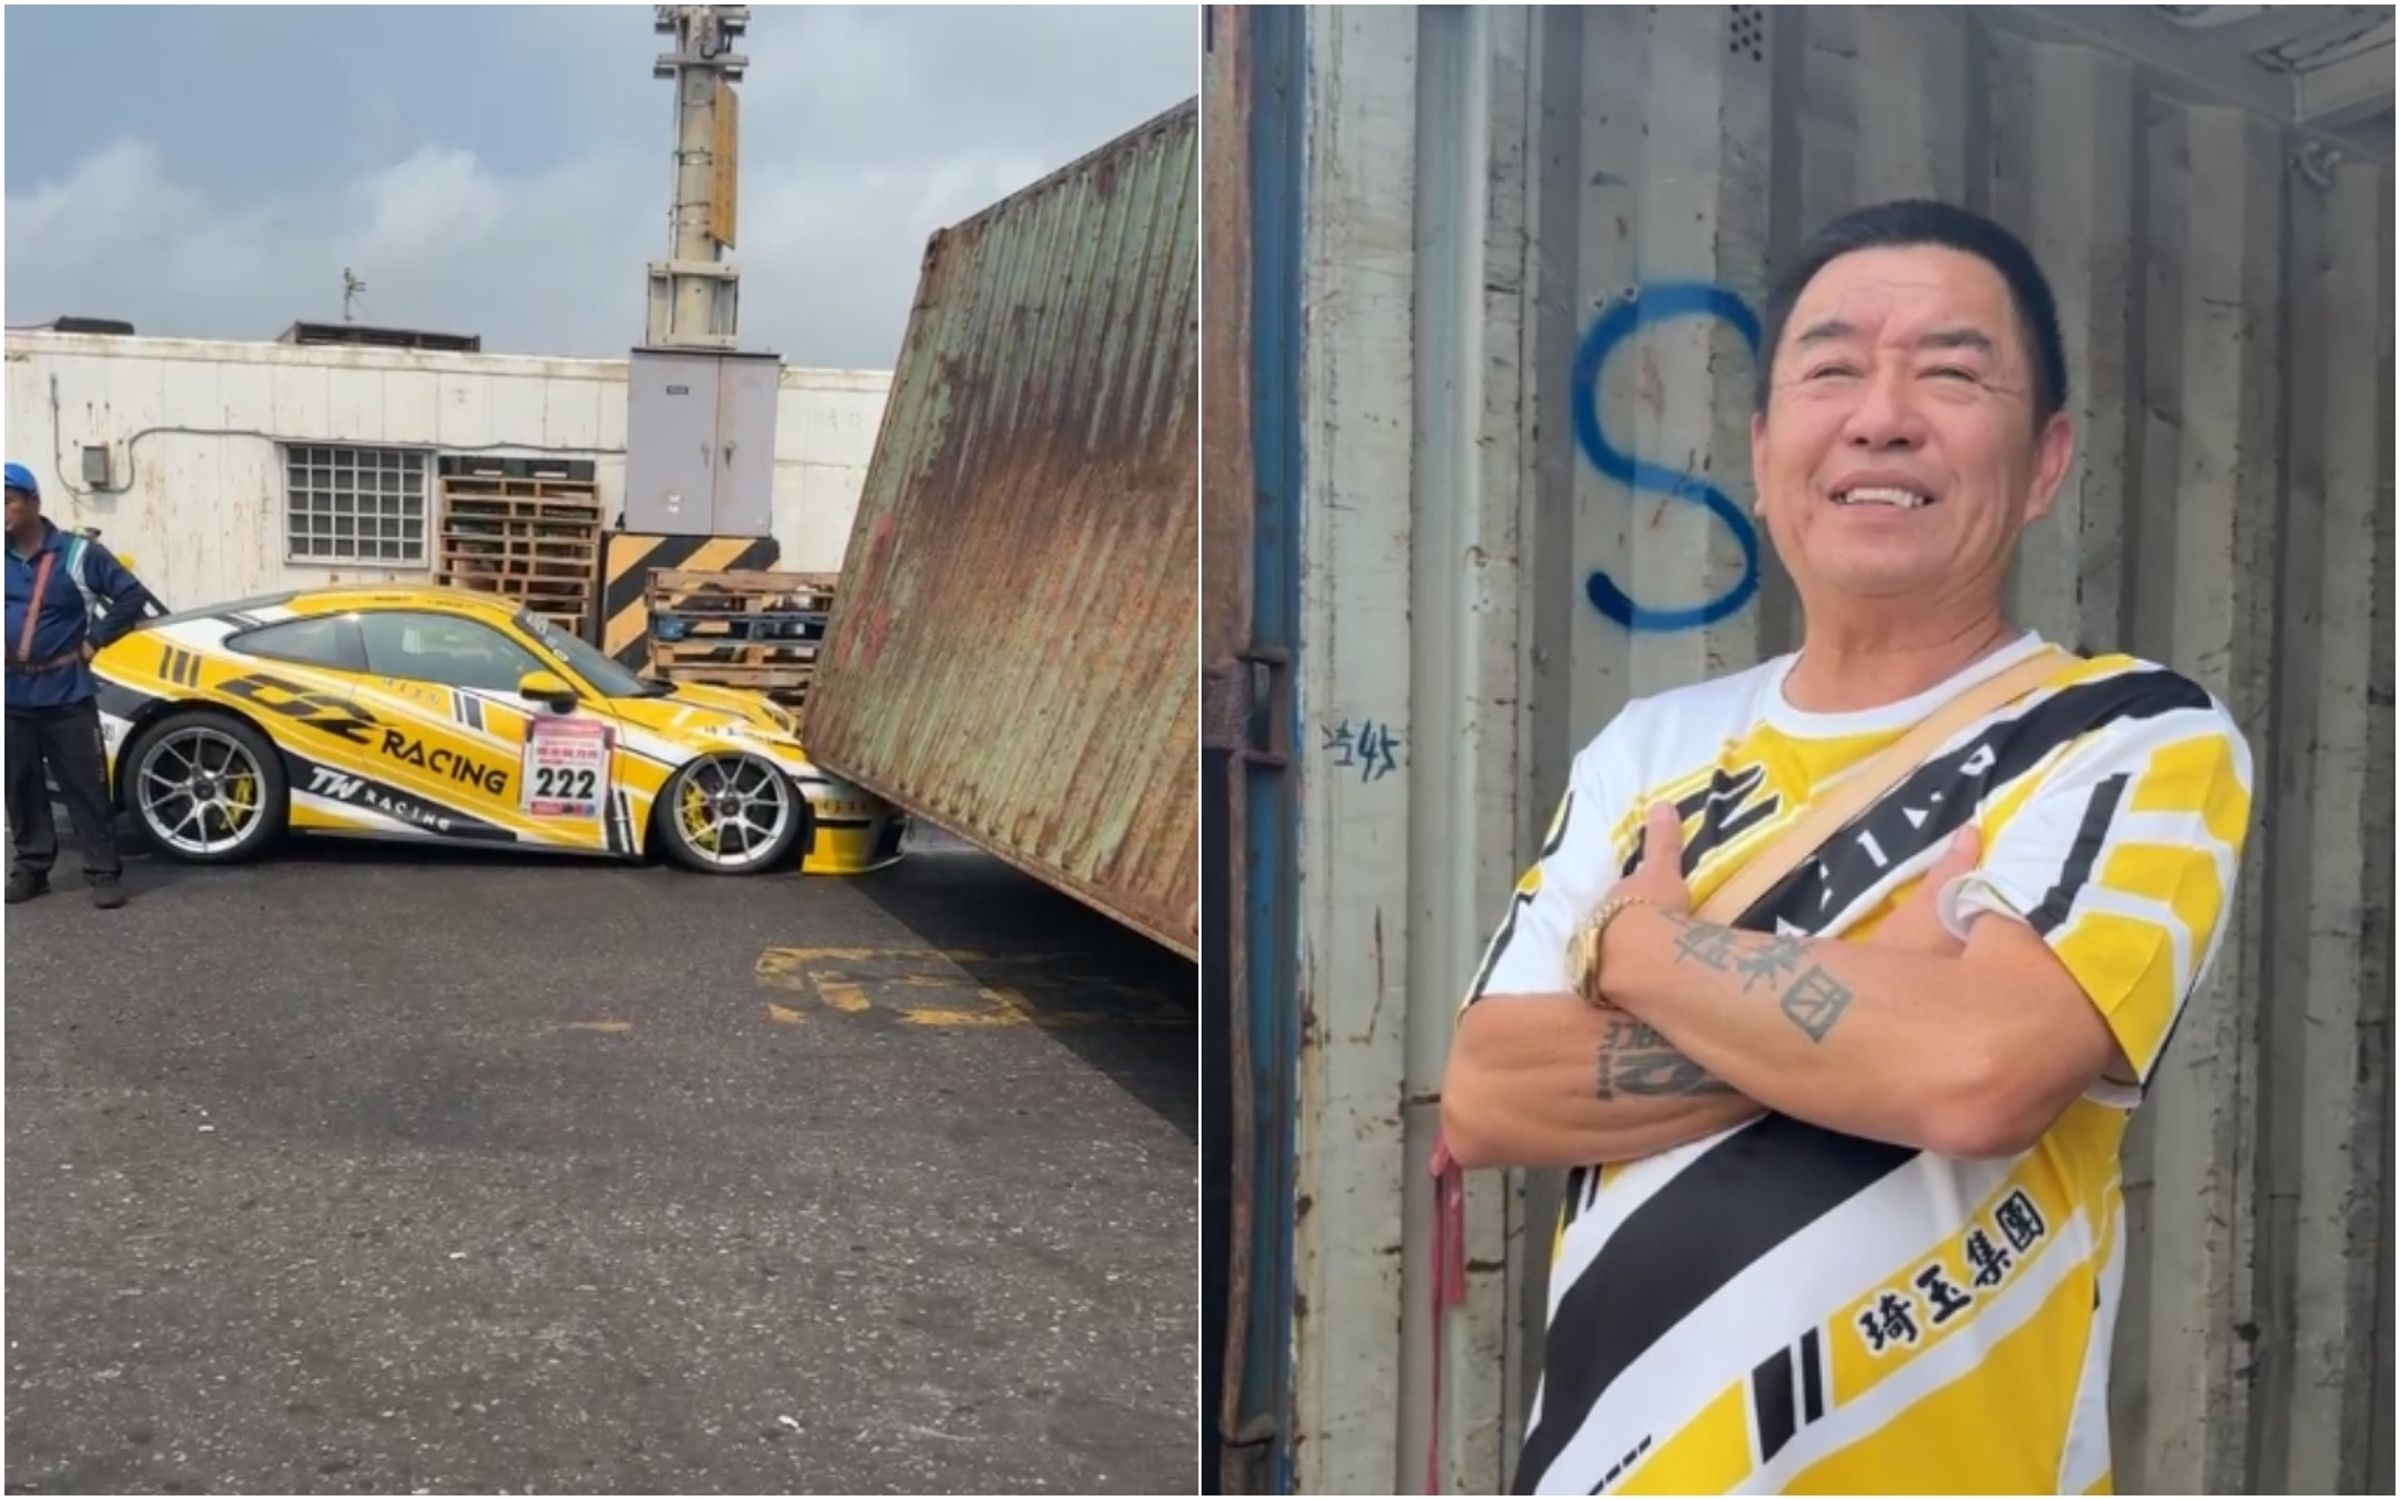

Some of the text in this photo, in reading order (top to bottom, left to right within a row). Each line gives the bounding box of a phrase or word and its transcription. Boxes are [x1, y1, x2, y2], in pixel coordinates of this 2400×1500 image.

[380, 729, 509, 795] RACING
[535, 767, 597, 800] 222
[308, 766, 451, 831] TW RACING
[1859, 1188, 2045, 1351] 琦玉集團
